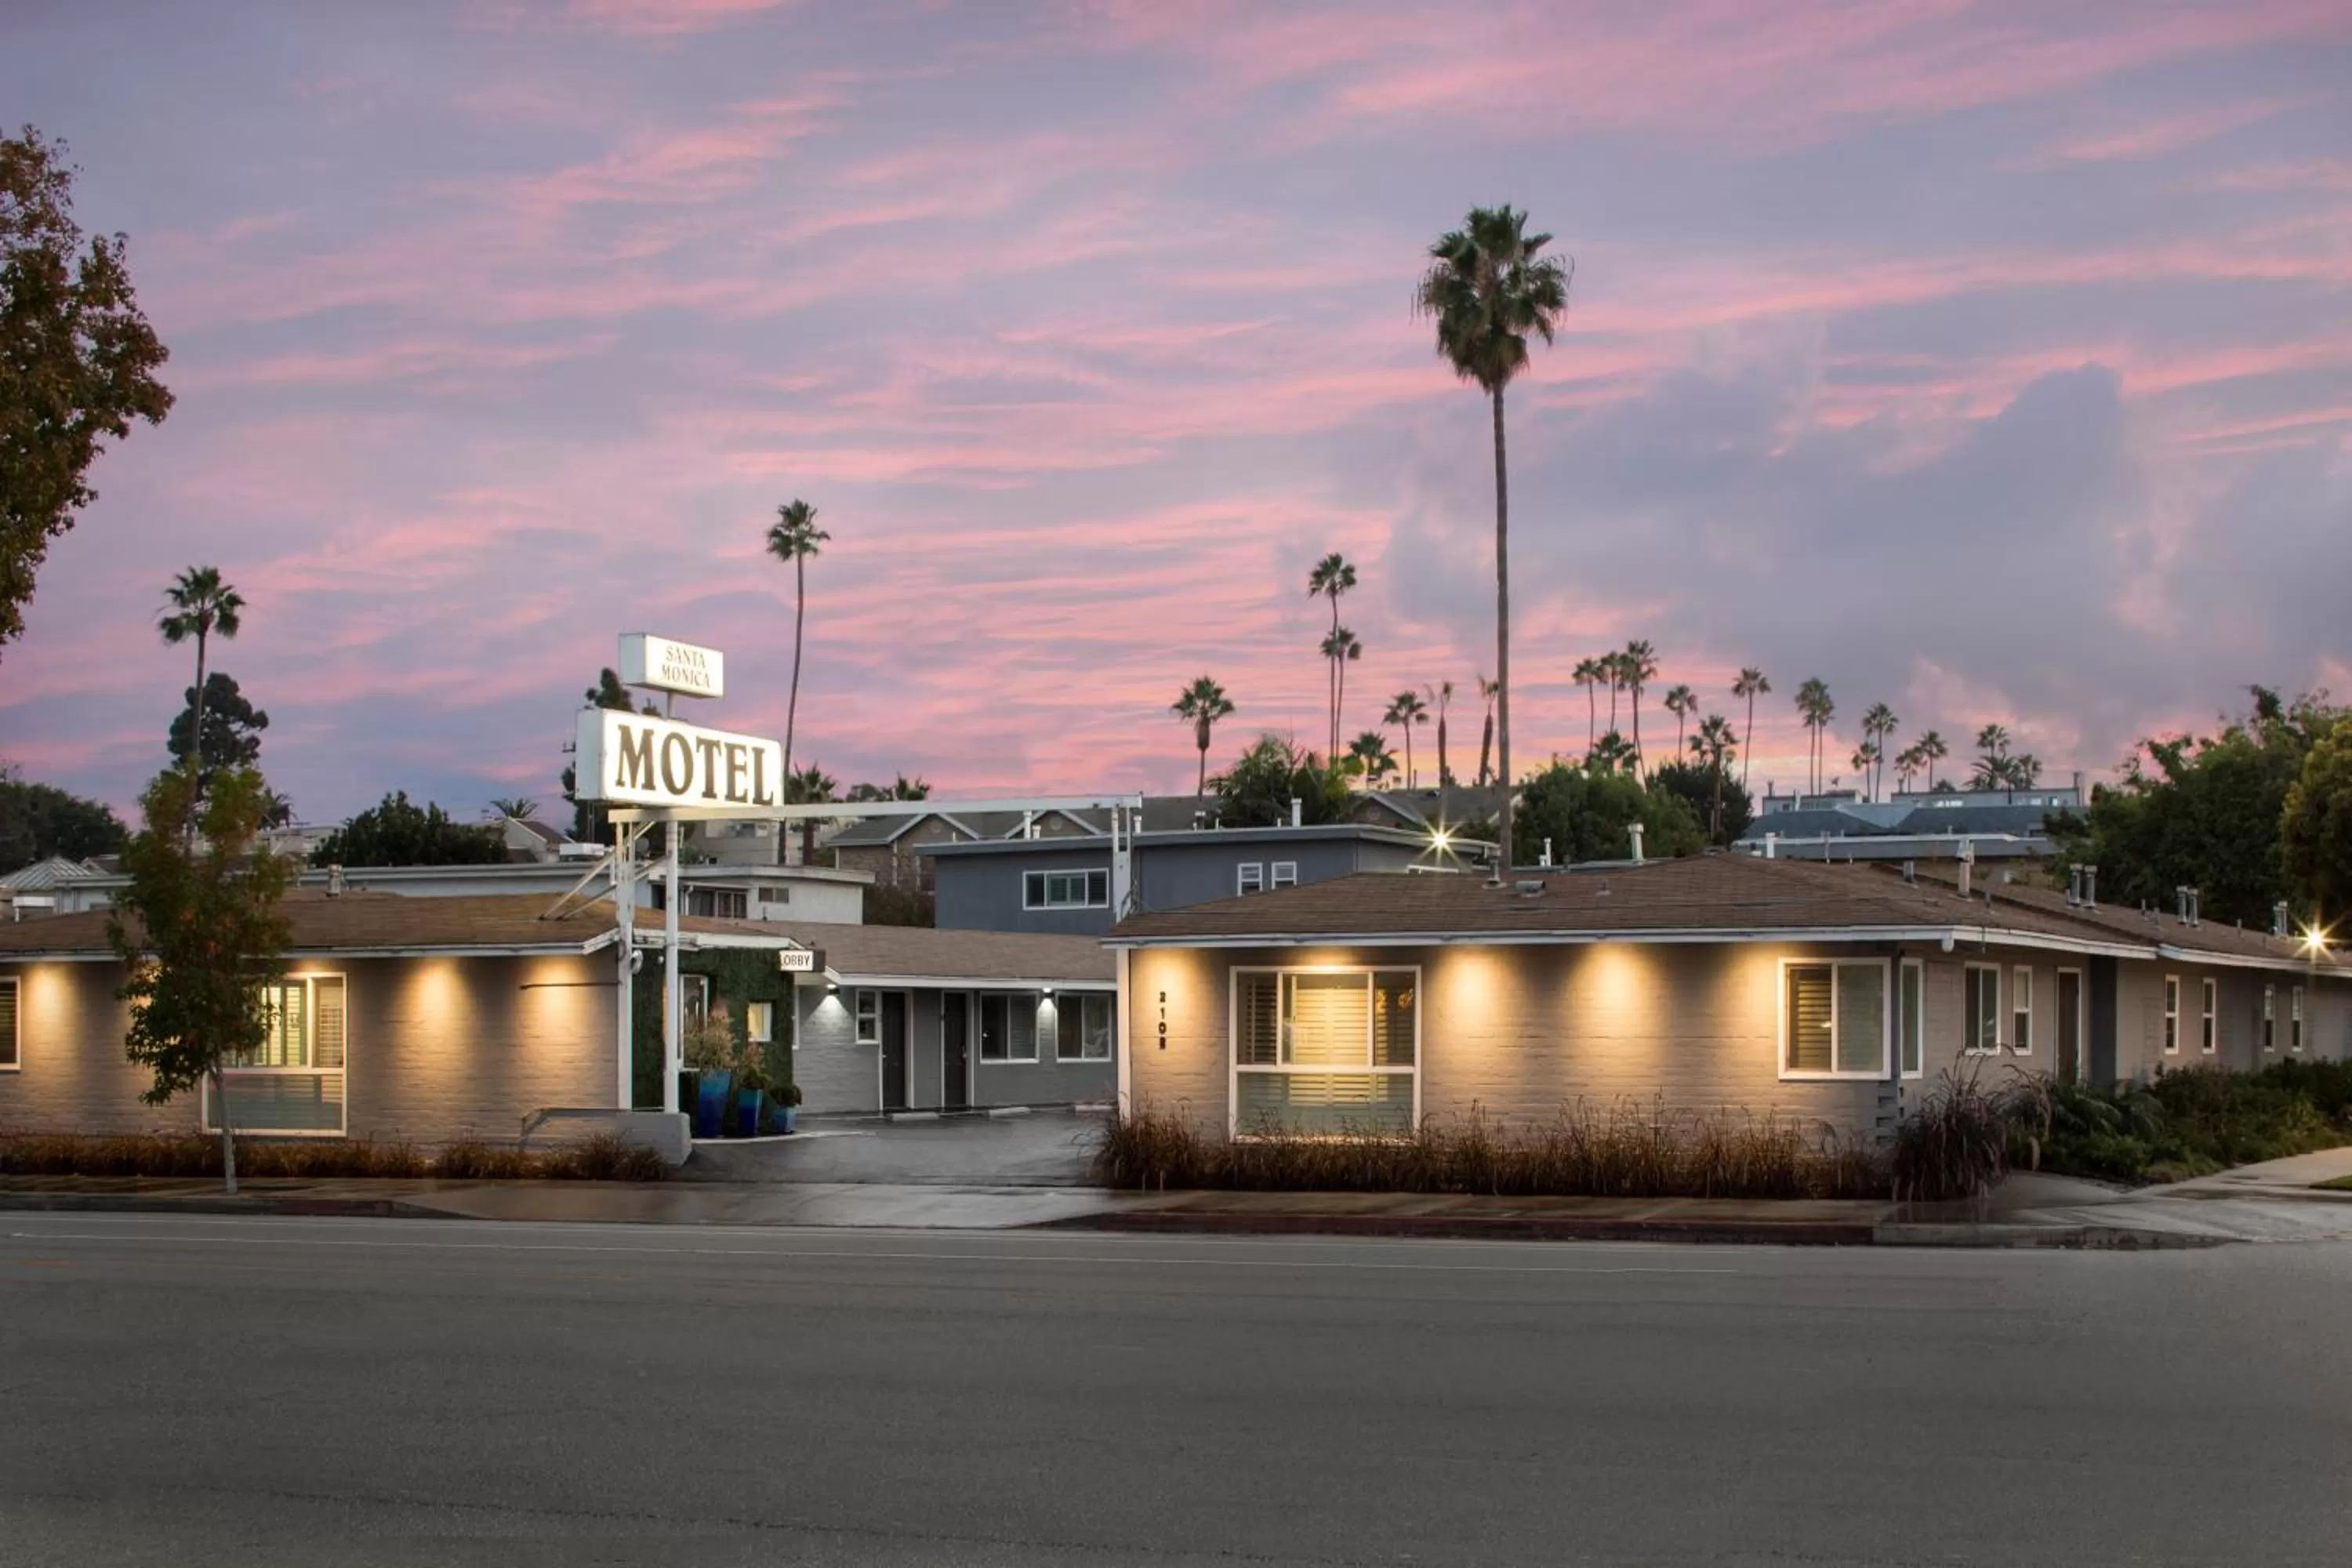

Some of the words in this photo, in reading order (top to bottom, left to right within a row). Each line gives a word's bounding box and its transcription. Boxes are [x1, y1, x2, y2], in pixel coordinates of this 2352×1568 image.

[666, 645, 706, 669] SANTA
[662, 664, 710, 688] MONICA
[615, 724, 774, 805] MOTEL
[782, 954, 810, 967] OBBY
